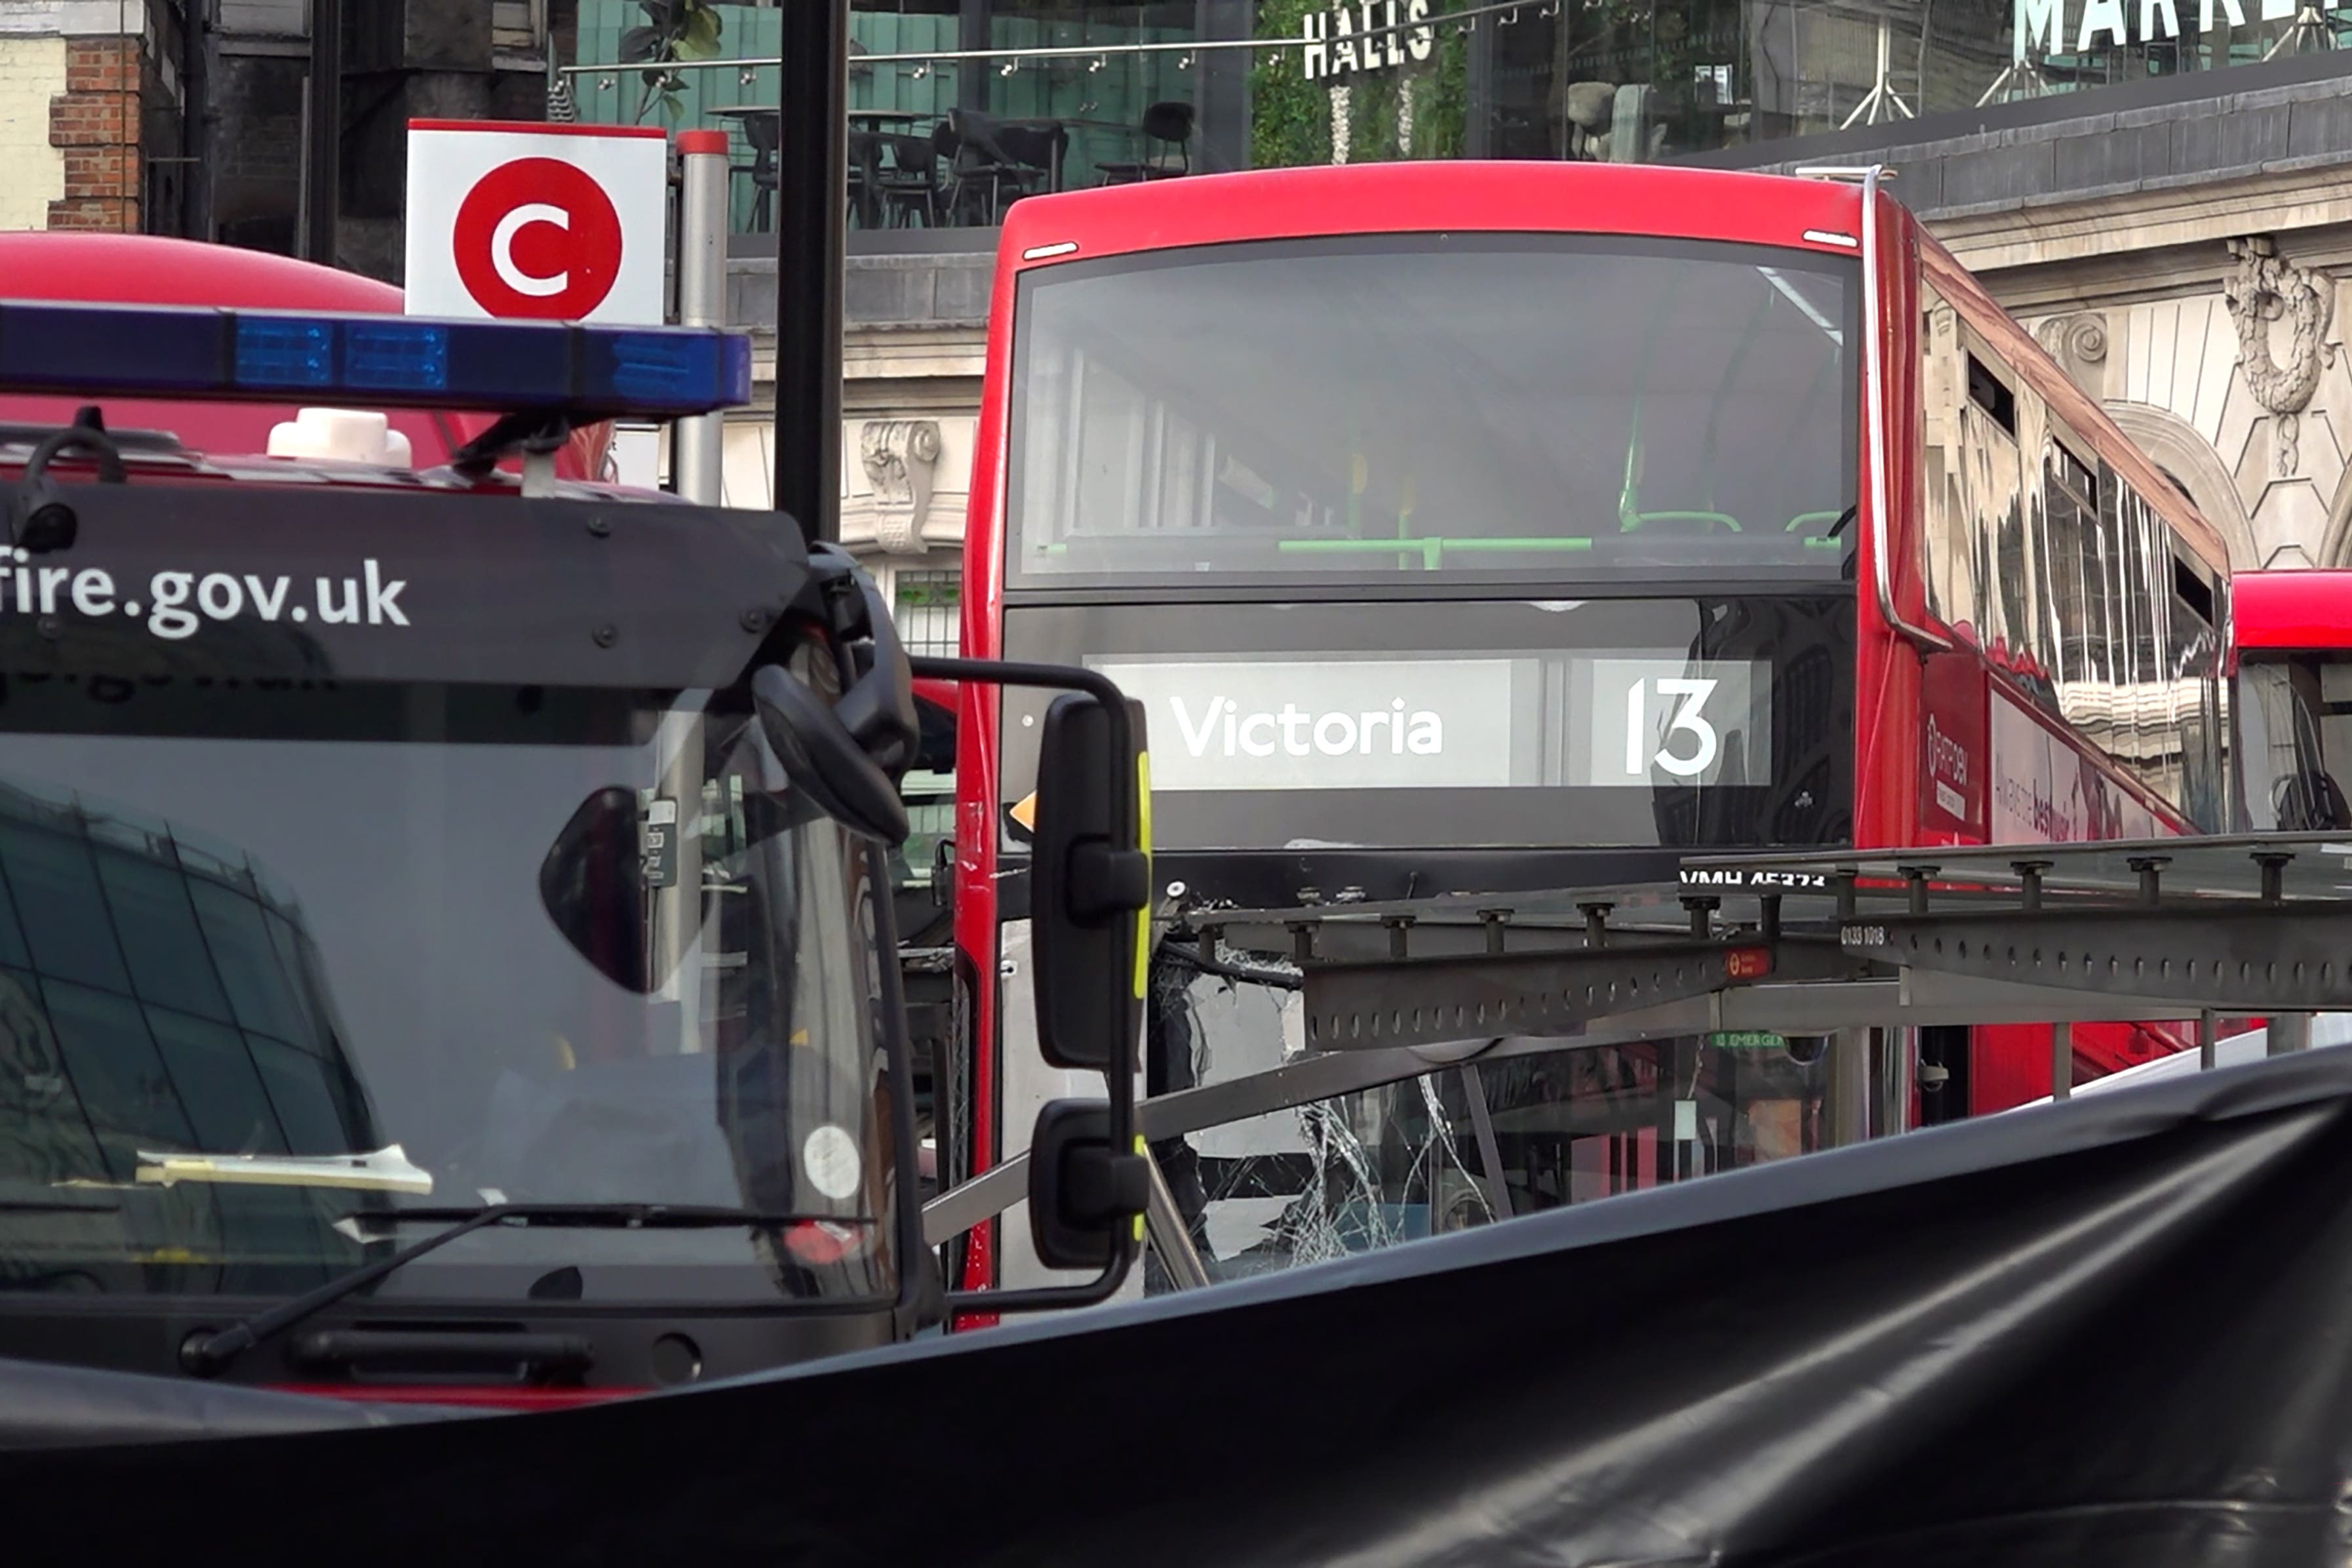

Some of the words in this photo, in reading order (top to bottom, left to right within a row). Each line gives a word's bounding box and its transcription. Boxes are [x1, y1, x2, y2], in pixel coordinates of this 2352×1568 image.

[1304, 0, 1432, 79] HALLS
[492, 203, 569, 296] C
[1169, 696, 1443, 757] Victoria
[1626, 677, 1718, 776] 13
